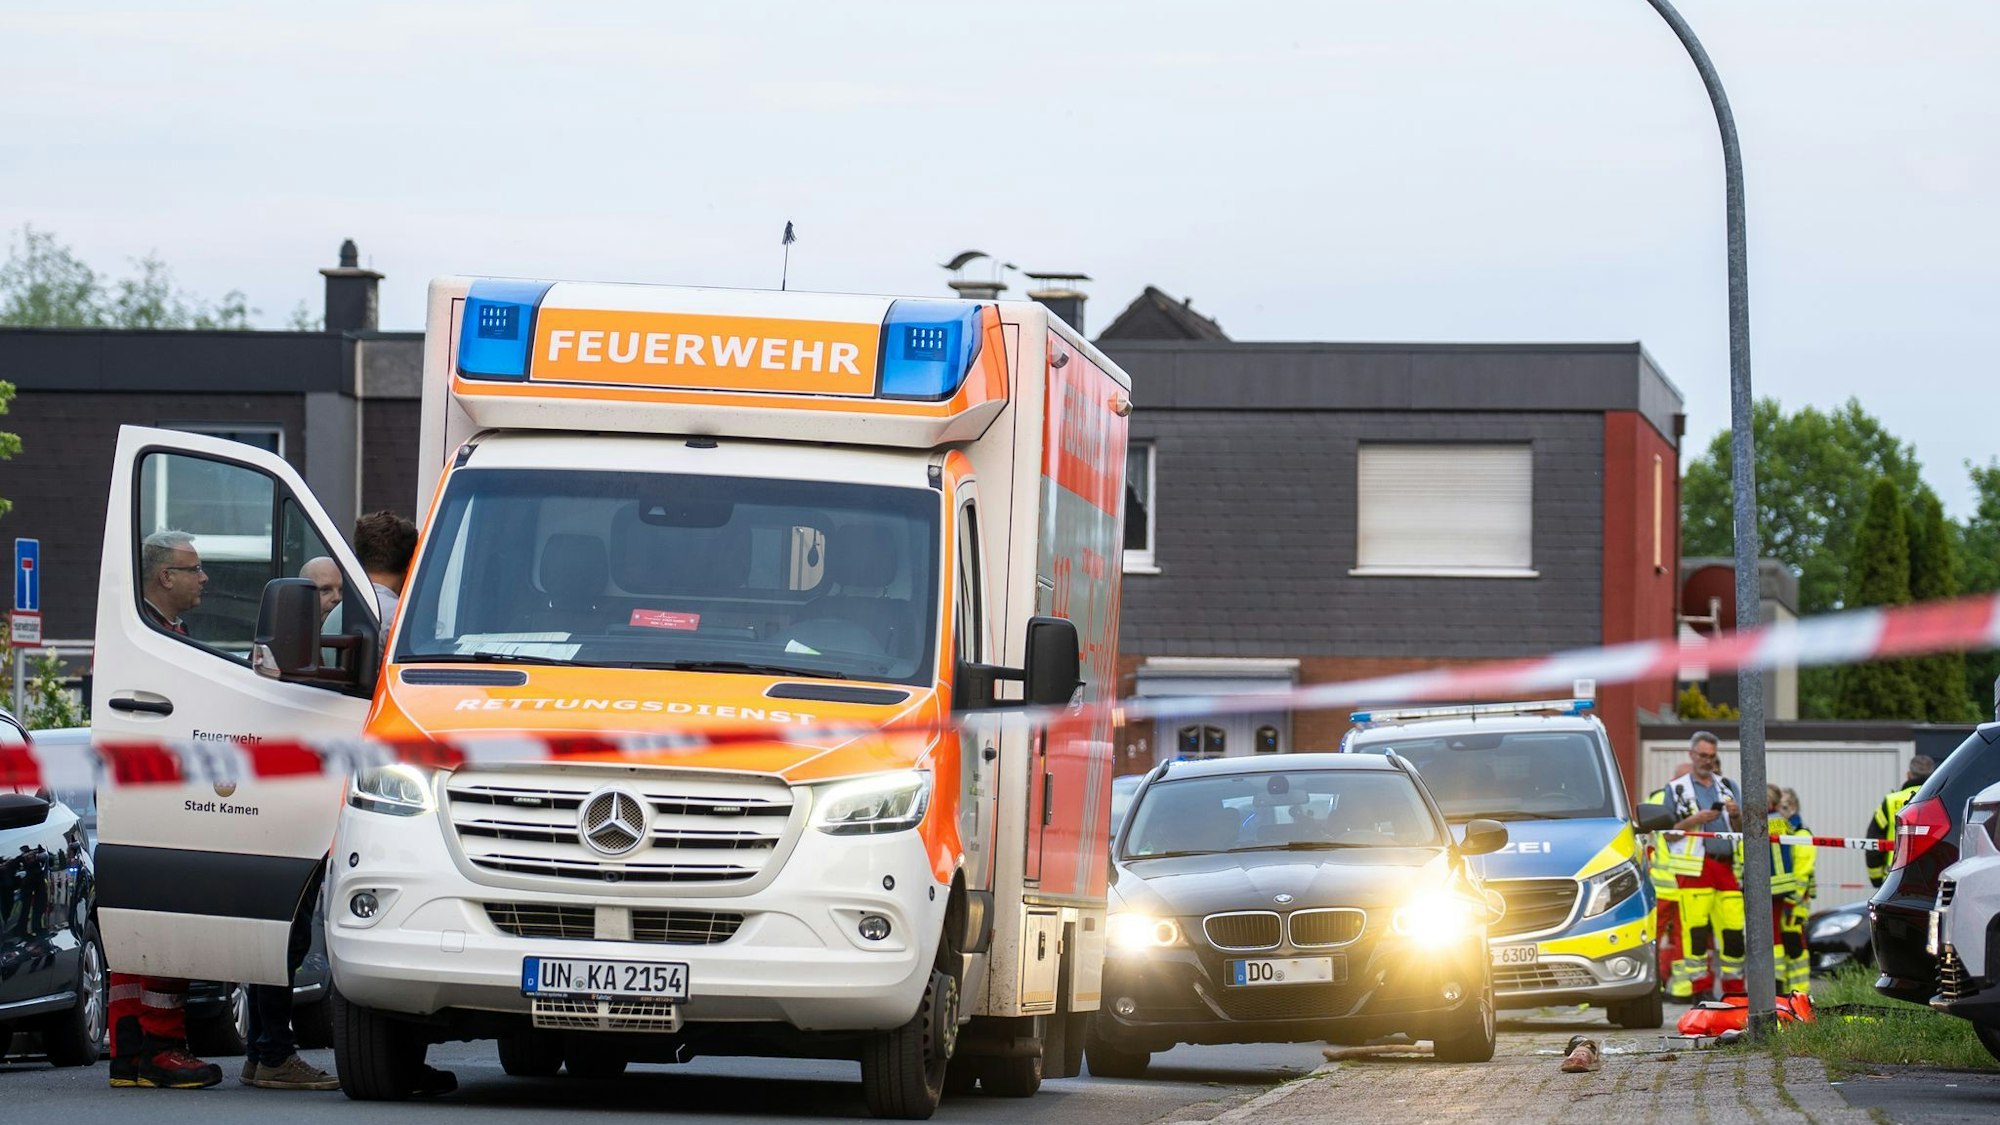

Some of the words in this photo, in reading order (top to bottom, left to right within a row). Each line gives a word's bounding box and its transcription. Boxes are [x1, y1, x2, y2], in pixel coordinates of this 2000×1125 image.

[547, 329, 862, 376] FEUERWEHR
[455, 698, 816, 726] RETTUNGSDIENST
[192, 729, 263, 745] Feuerwehr
[184, 800, 216, 812] Stadt
[219, 803, 259, 815] Kamen
[542, 962, 572, 989] UN
[587, 964, 617, 991] KA
[623, 966, 682, 993] 2154
[1248, 962, 1273, 981] DO
